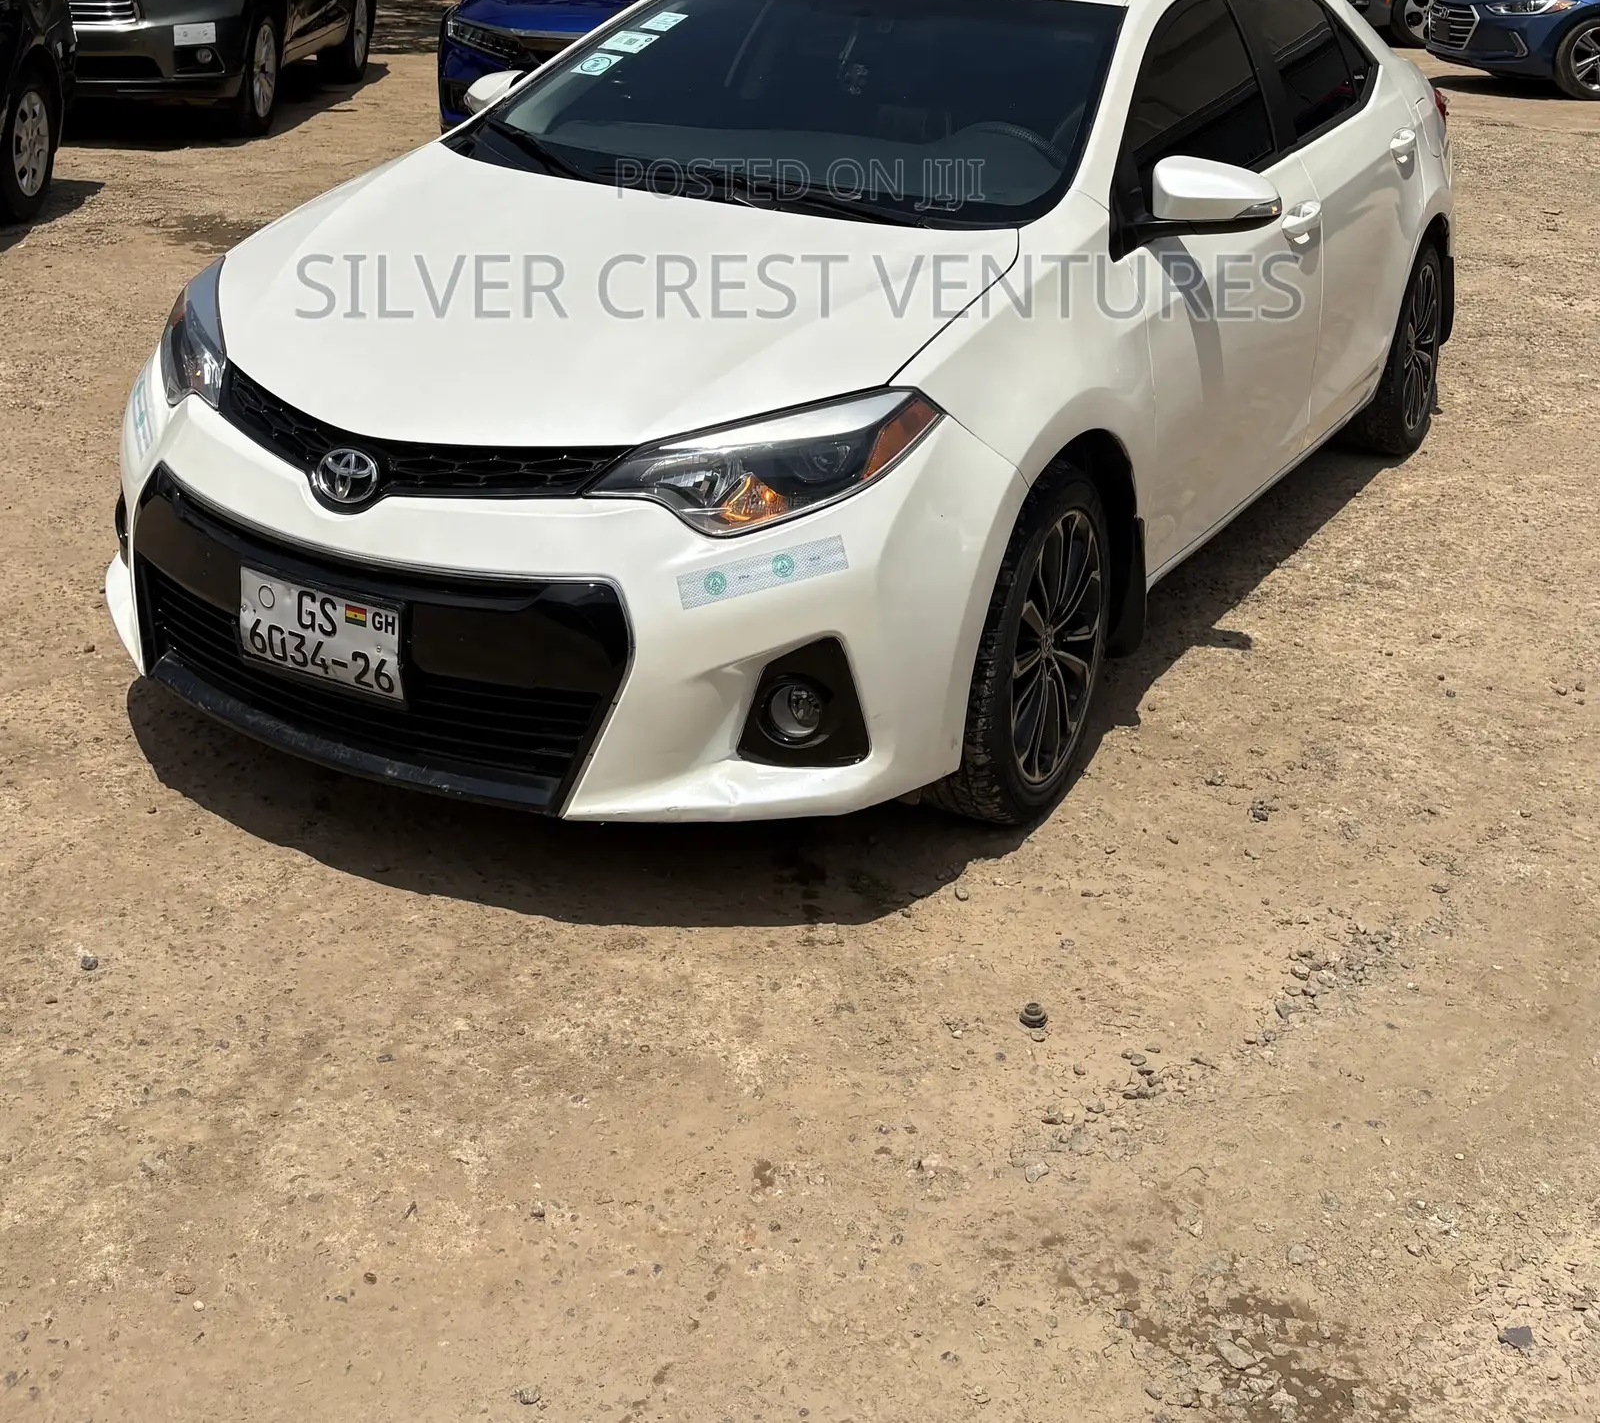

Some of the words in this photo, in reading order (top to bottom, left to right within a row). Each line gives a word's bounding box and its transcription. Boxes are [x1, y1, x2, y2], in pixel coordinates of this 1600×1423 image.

[297, 590, 337, 637] GS
[371, 611, 396, 636] GH
[249, 618, 395, 694] 6034-26
